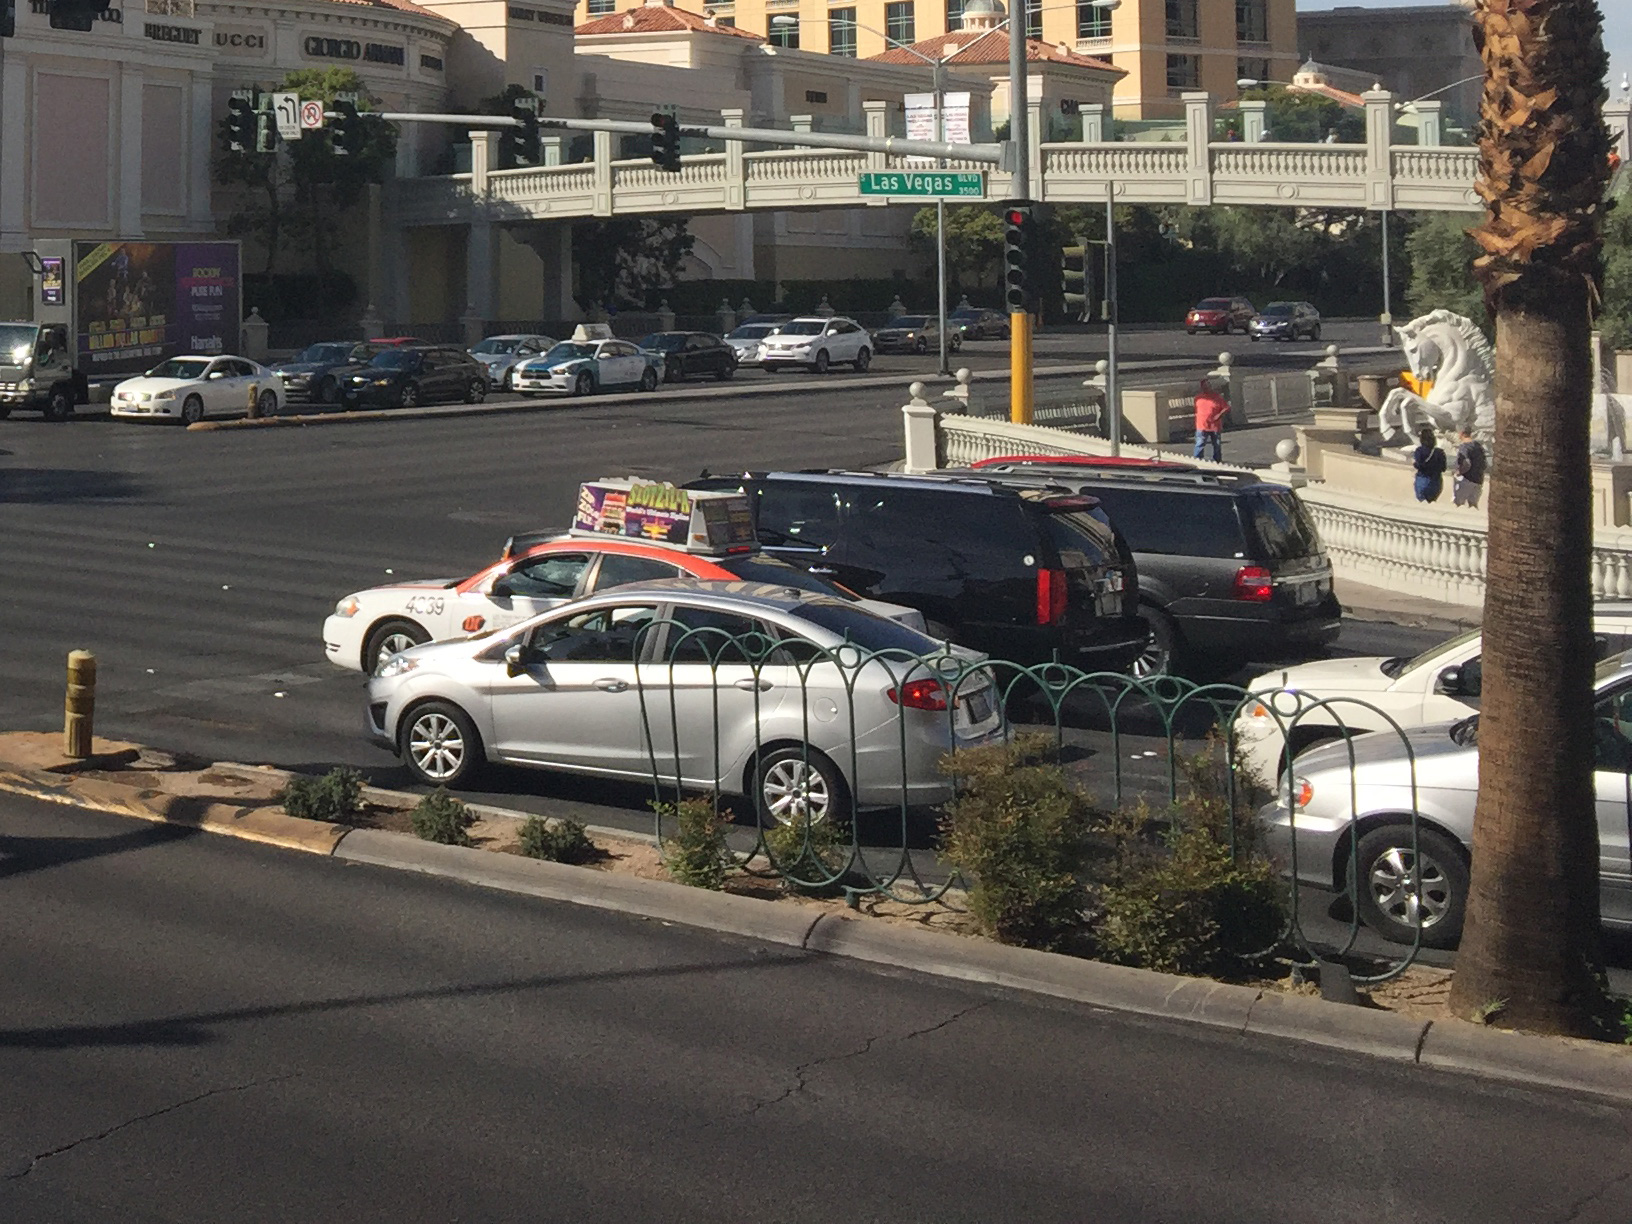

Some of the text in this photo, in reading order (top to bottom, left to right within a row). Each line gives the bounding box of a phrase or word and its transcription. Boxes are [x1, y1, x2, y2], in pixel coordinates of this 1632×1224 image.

[215, 31, 265, 49] UCCI
[303, 35, 362, 60] GIORGIO
[870, 173, 899, 191] Las
[904, 173, 953, 195] Vegas
[957, 173, 979, 183] BLVD
